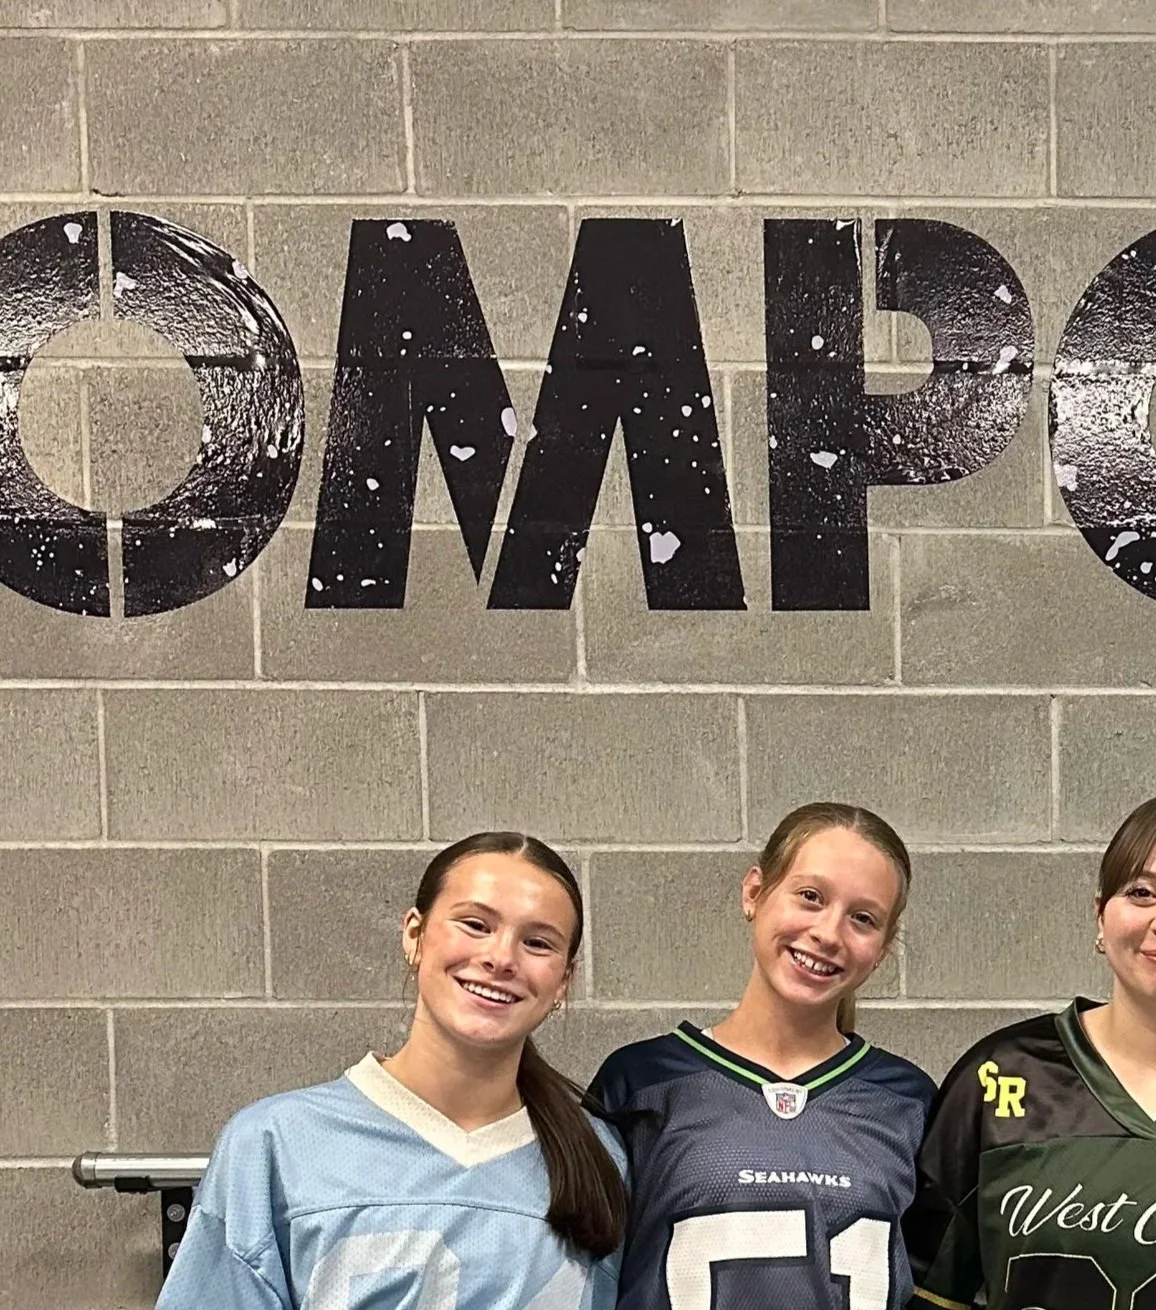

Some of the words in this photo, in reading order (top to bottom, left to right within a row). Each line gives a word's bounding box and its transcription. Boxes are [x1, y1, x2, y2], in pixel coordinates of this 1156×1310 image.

[978, 1060, 1026, 1117] SR
[738, 1169, 851, 1187] SEAHAWKS
[1001, 1183, 1137, 1236] West
